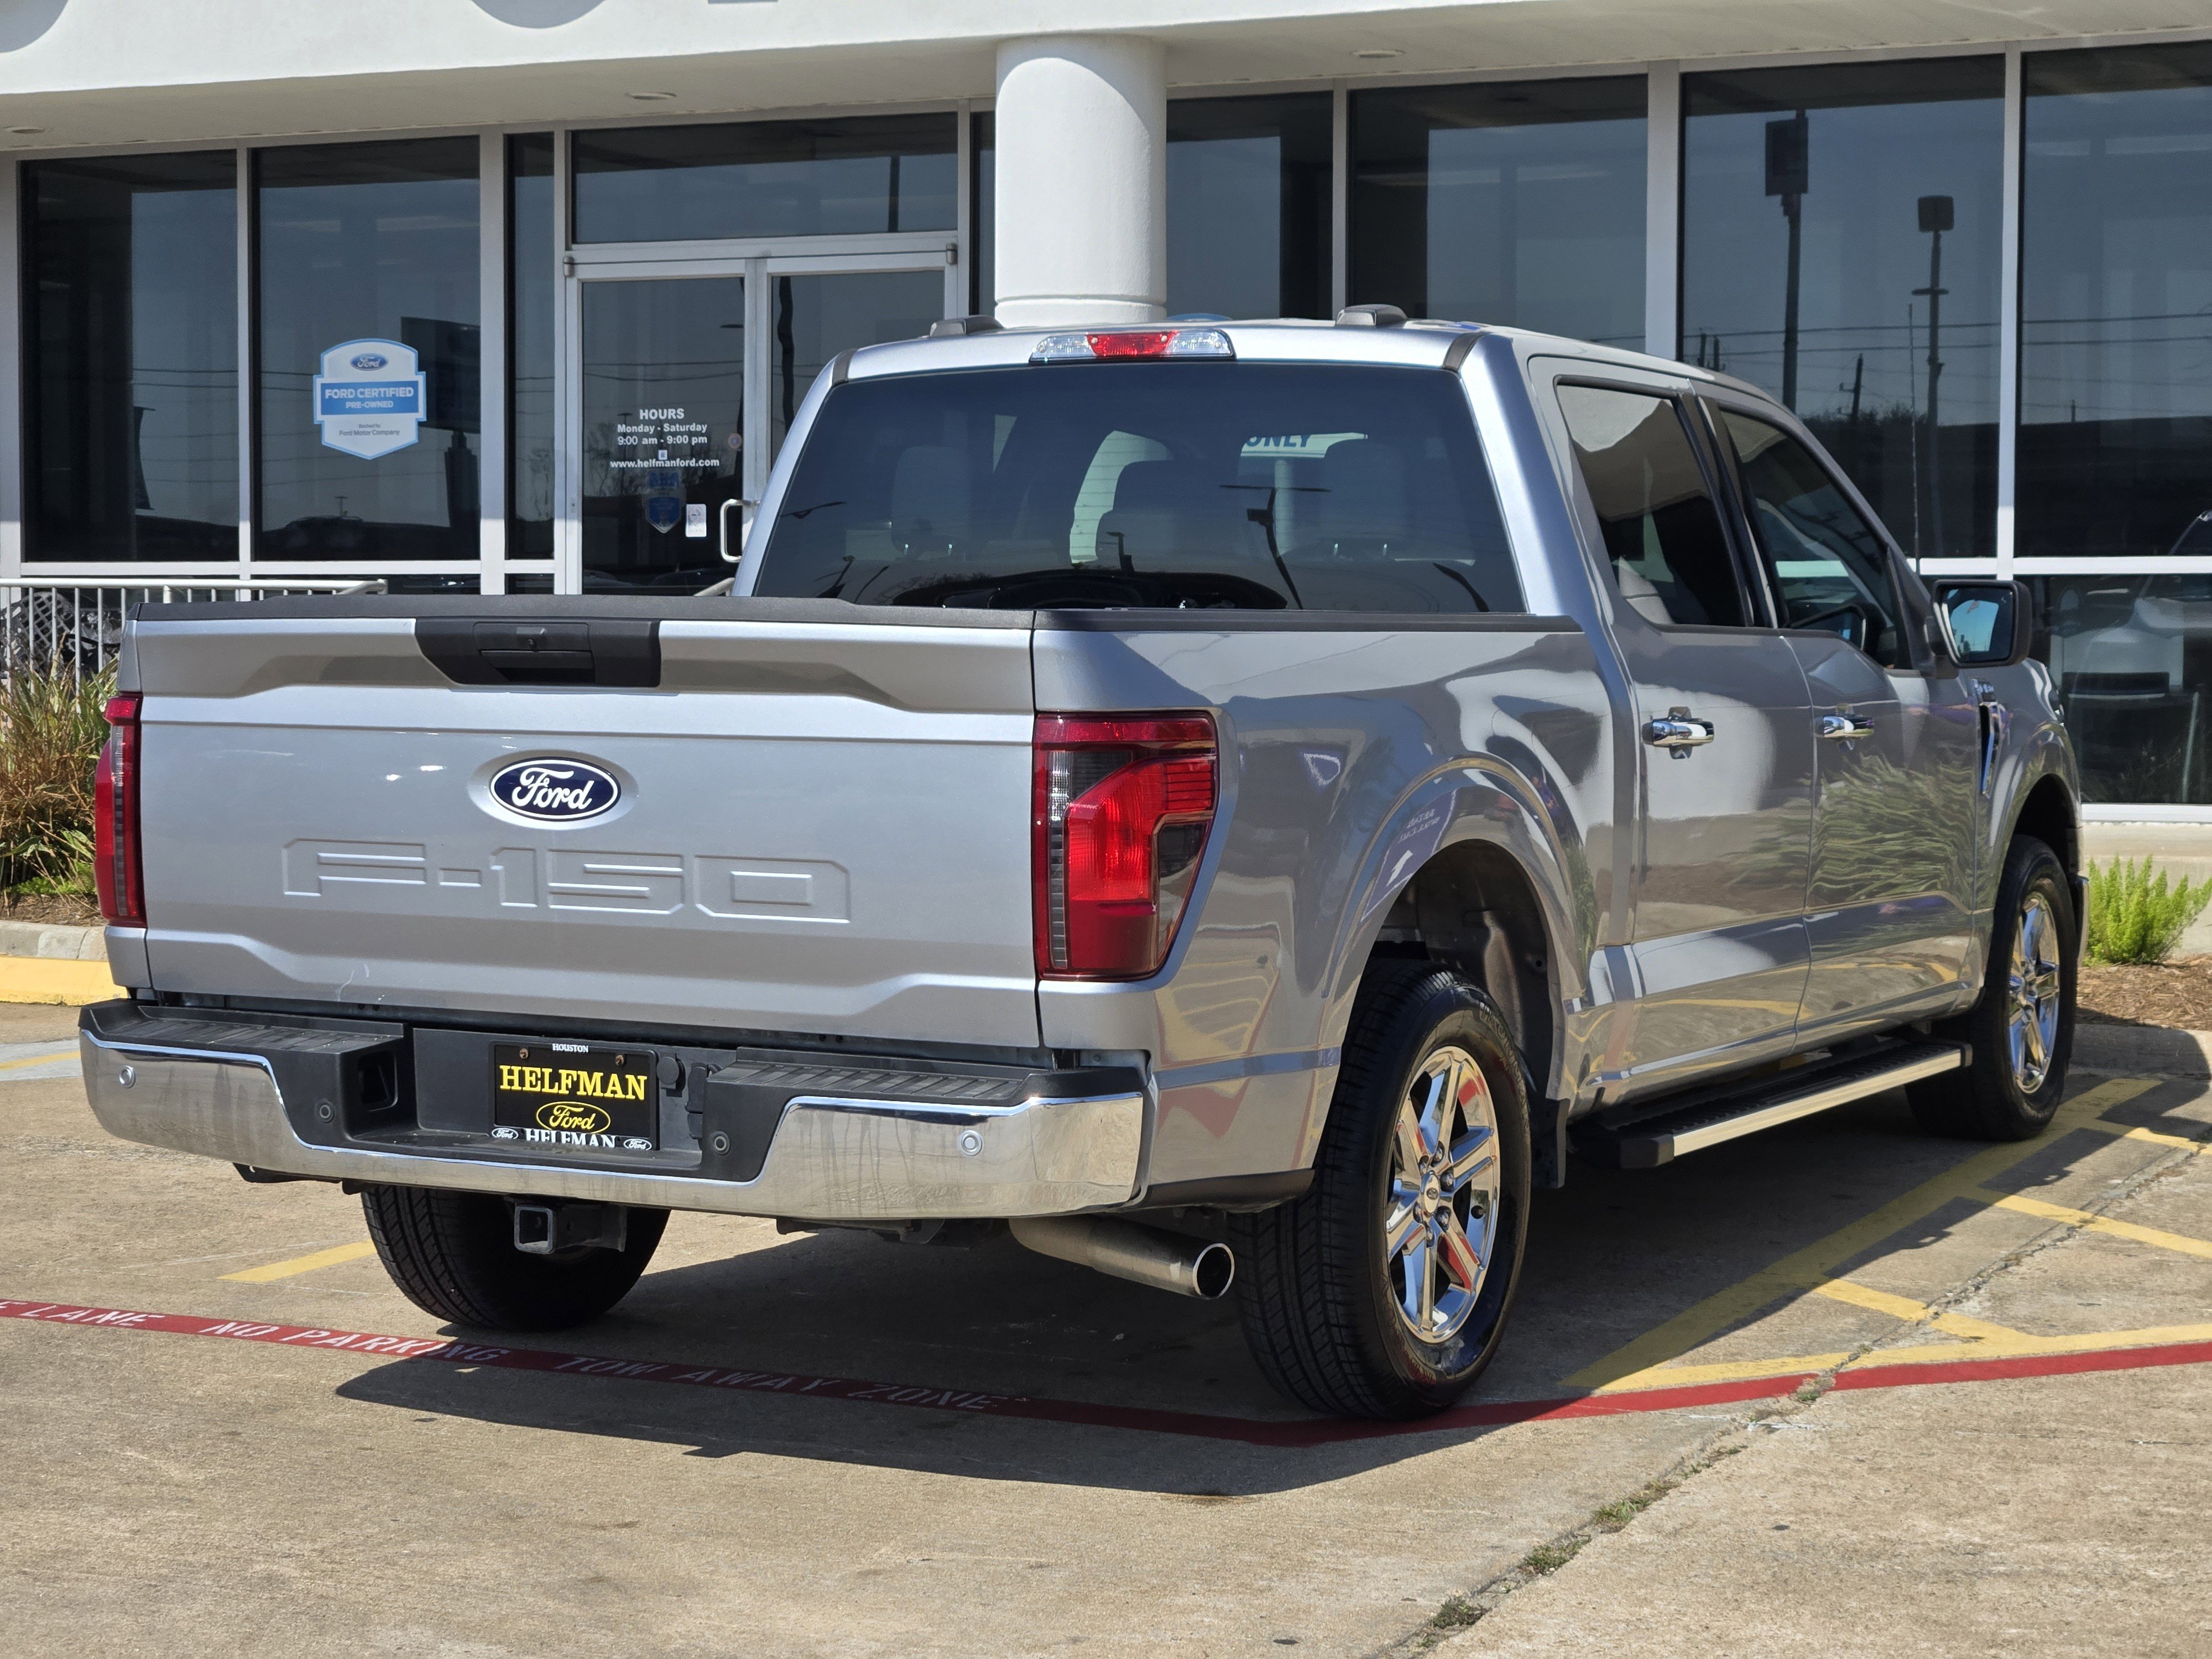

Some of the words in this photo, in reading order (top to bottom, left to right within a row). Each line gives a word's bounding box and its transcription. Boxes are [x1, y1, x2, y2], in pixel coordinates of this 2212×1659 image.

[357, 355, 381, 368] Ford
[325, 389, 355, 399] FORD
[357, 387, 414, 398] CERTIFIED
[346, 400, 394, 409] PRE-OWNED
[639, 408, 685, 420] HOURS
[617, 424, 655, 434] Monday
[663, 423, 707, 434] Saturday
[617, 436, 638, 445] 9:00
[667, 435, 688, 444] 9:00
[691, 437, 708, 445] pm
[609, 458, 719, 468] www.helfmanford.com
[511, 766, 594, 811] Ford
[283, 838, 850, 924] F-150
[552, 1043, 589, 1053] HOUSTON
[499, 1065, 648, 1100] HELFMAN
[549, 1104, 597, 1130] Ford
[18, 1305, 165, 1326] LANE
[198, 1322, 280, 1337] NO
[279, 1329, 510, 1361] PARKING
[554, 1357, 669, 1376] TOW
[670, 1369, 842, 1392] AWAY
[847, 1384, 1009, 1409] ZONE
